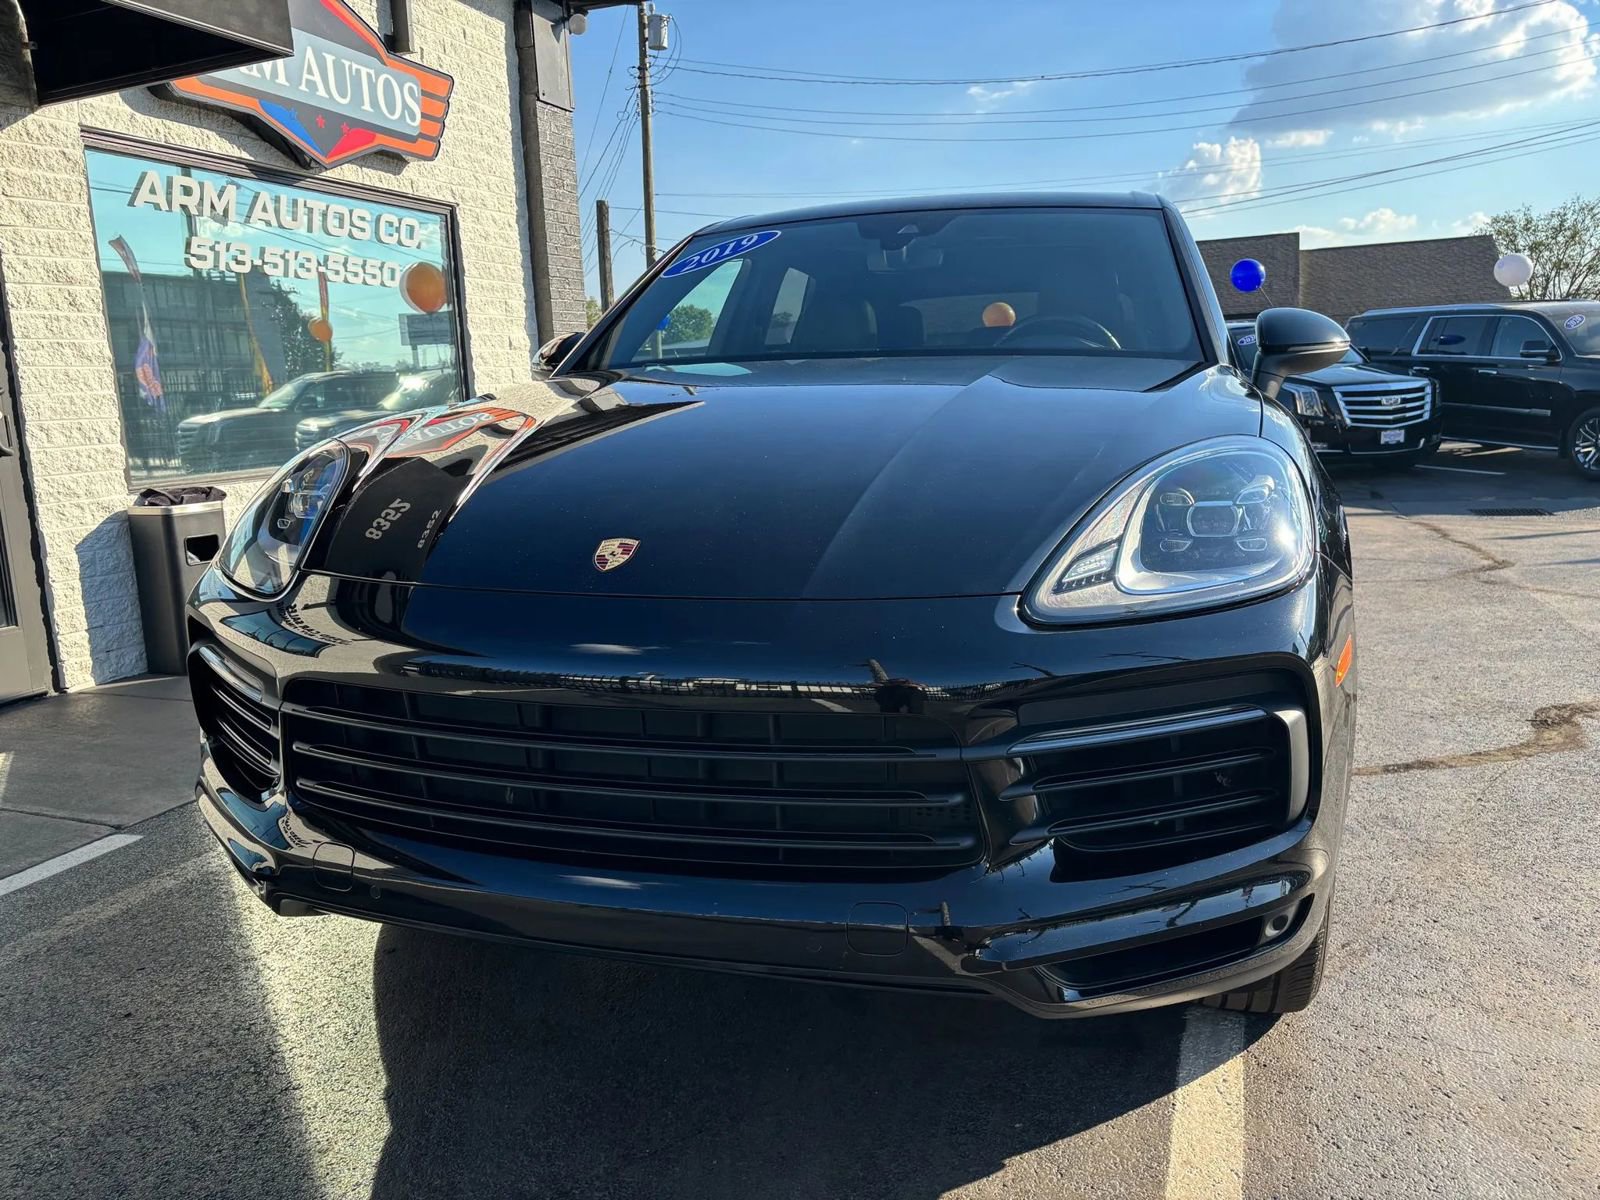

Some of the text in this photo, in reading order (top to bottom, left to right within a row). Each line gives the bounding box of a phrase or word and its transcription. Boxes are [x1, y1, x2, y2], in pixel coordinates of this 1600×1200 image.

[298, 45, 422, 127] AUTOS
[130, 170, 238, 222] ARM
[246, 191, 372, 241] AUTOS
[185, 235, 401, 288] 513-513-5550
[680, 235, 759, 272] 2019
